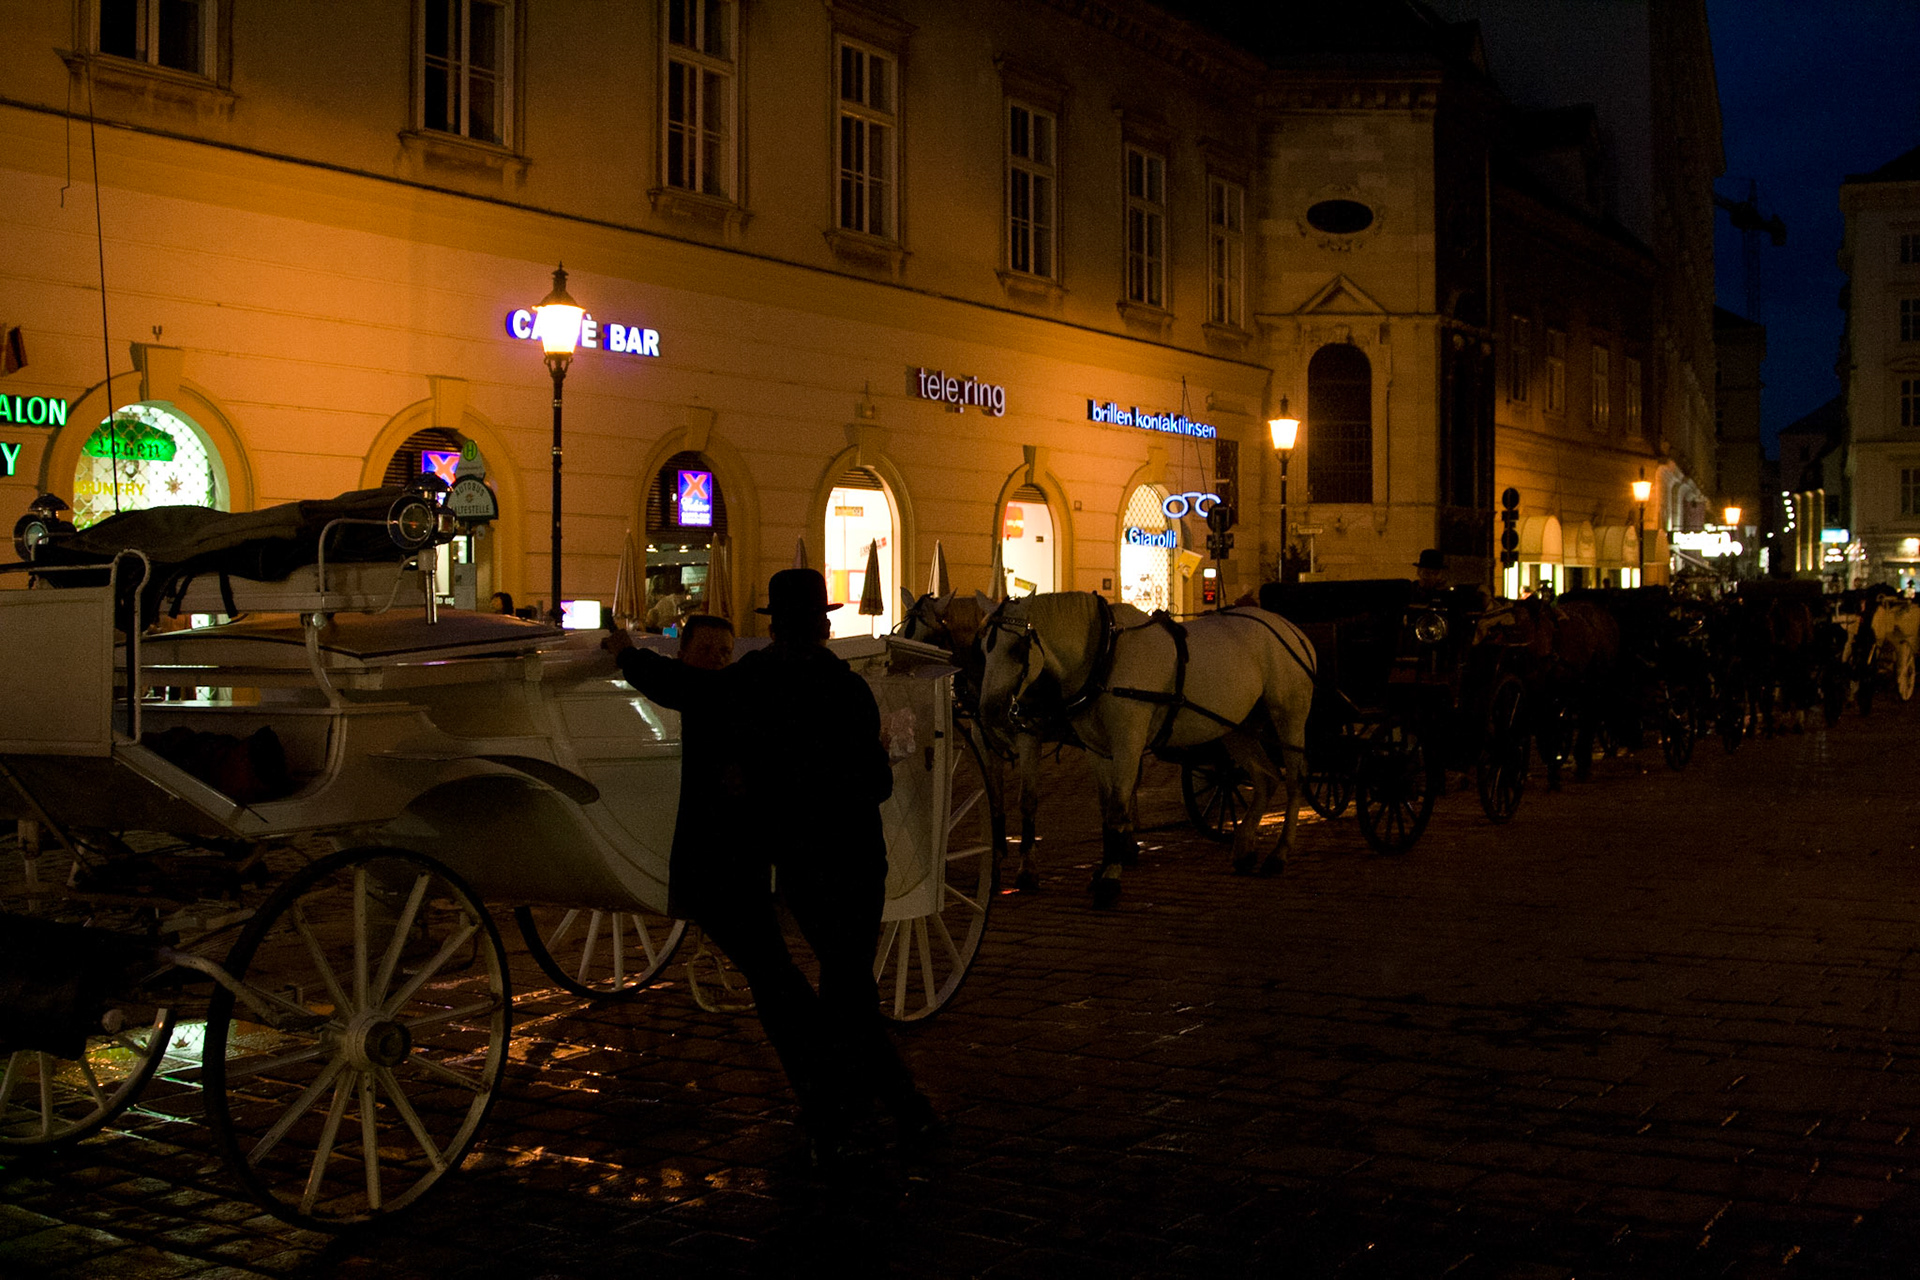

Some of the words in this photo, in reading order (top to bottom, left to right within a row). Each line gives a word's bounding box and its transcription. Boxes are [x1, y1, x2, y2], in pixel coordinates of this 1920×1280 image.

[509, 309, 597, 348] CÈ
[609, 323, 660, 357] BAR
[1092, 400, 1132, 426] brillen
[1135, 407, 1217, 438] kontaktlinsen
[455, 482, 485, 498] AUTOBUS
[1128, 526, 1177, 548] Giarolli
